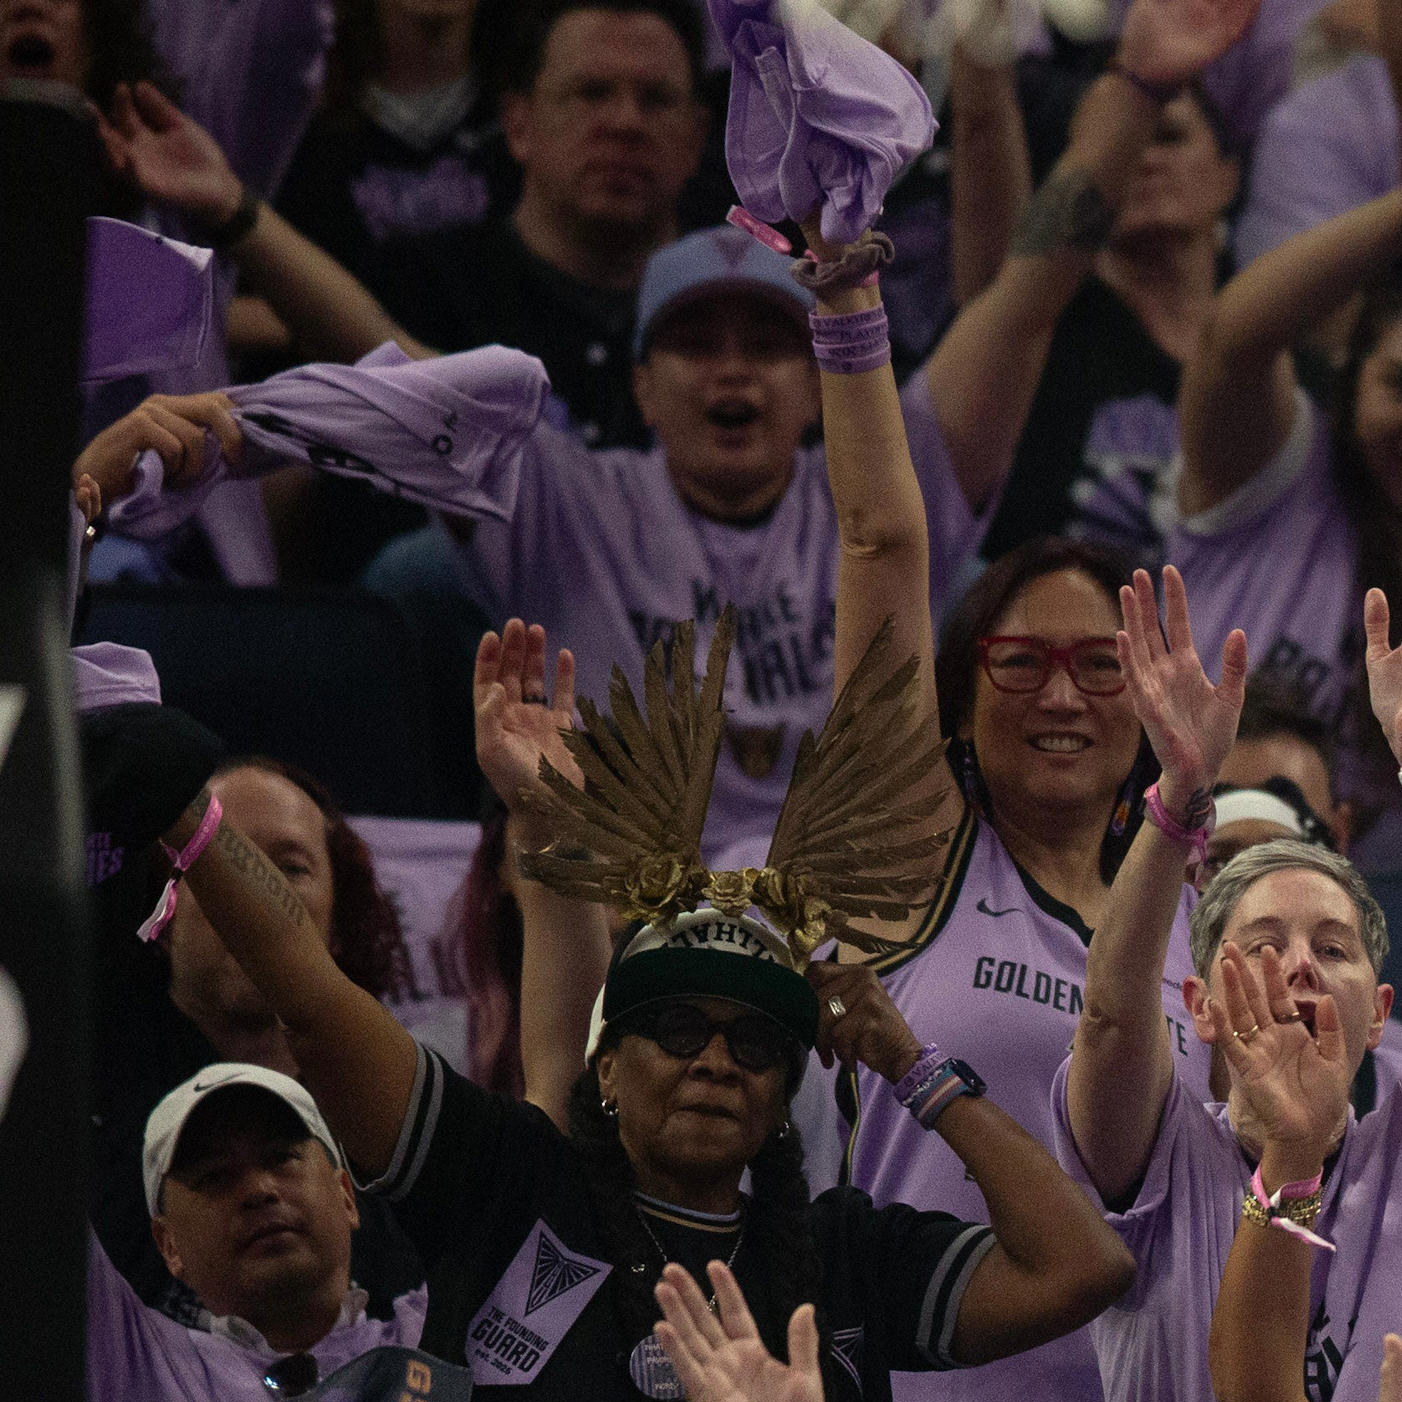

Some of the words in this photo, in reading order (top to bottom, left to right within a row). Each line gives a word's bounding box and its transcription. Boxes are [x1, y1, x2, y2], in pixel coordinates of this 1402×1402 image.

[973, 956, 1085, 1016] GOLDEN
[471, 1318, 540, 1373] GUARD
[504, 1317, 549, 1352] FOUNDING
